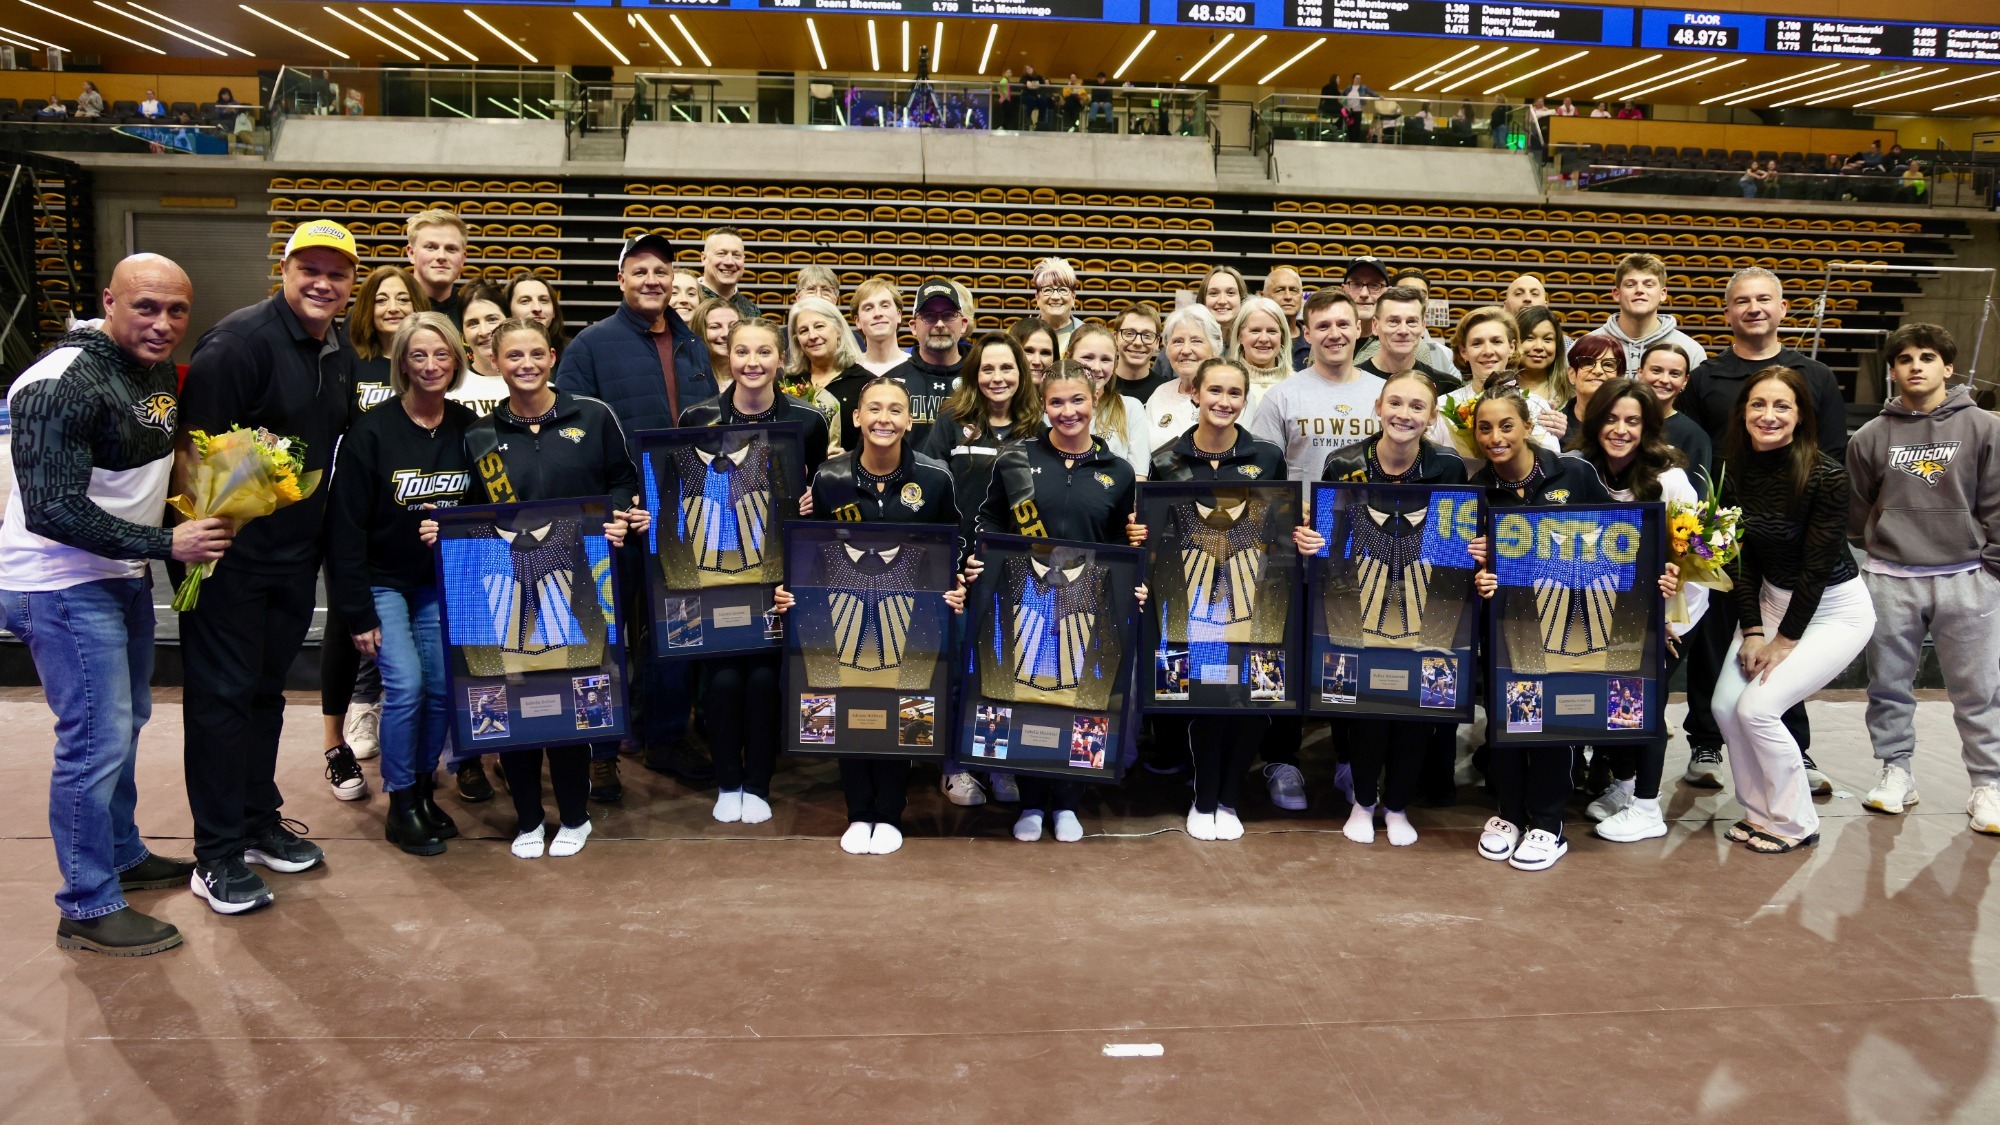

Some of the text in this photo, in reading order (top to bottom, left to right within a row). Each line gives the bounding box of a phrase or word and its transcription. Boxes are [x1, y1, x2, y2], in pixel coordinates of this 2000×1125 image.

[1189, 4, 1246, 22] 48.550
[1685, 14, 1720, 25] FLOOR
[1674, 29, 1727, 46] 48.975
[1297, 417, 1382, 437] TOWSO
[1889, 445, 1957, 468] TOWSON
[396, 472, 471, 501] TOWSON
